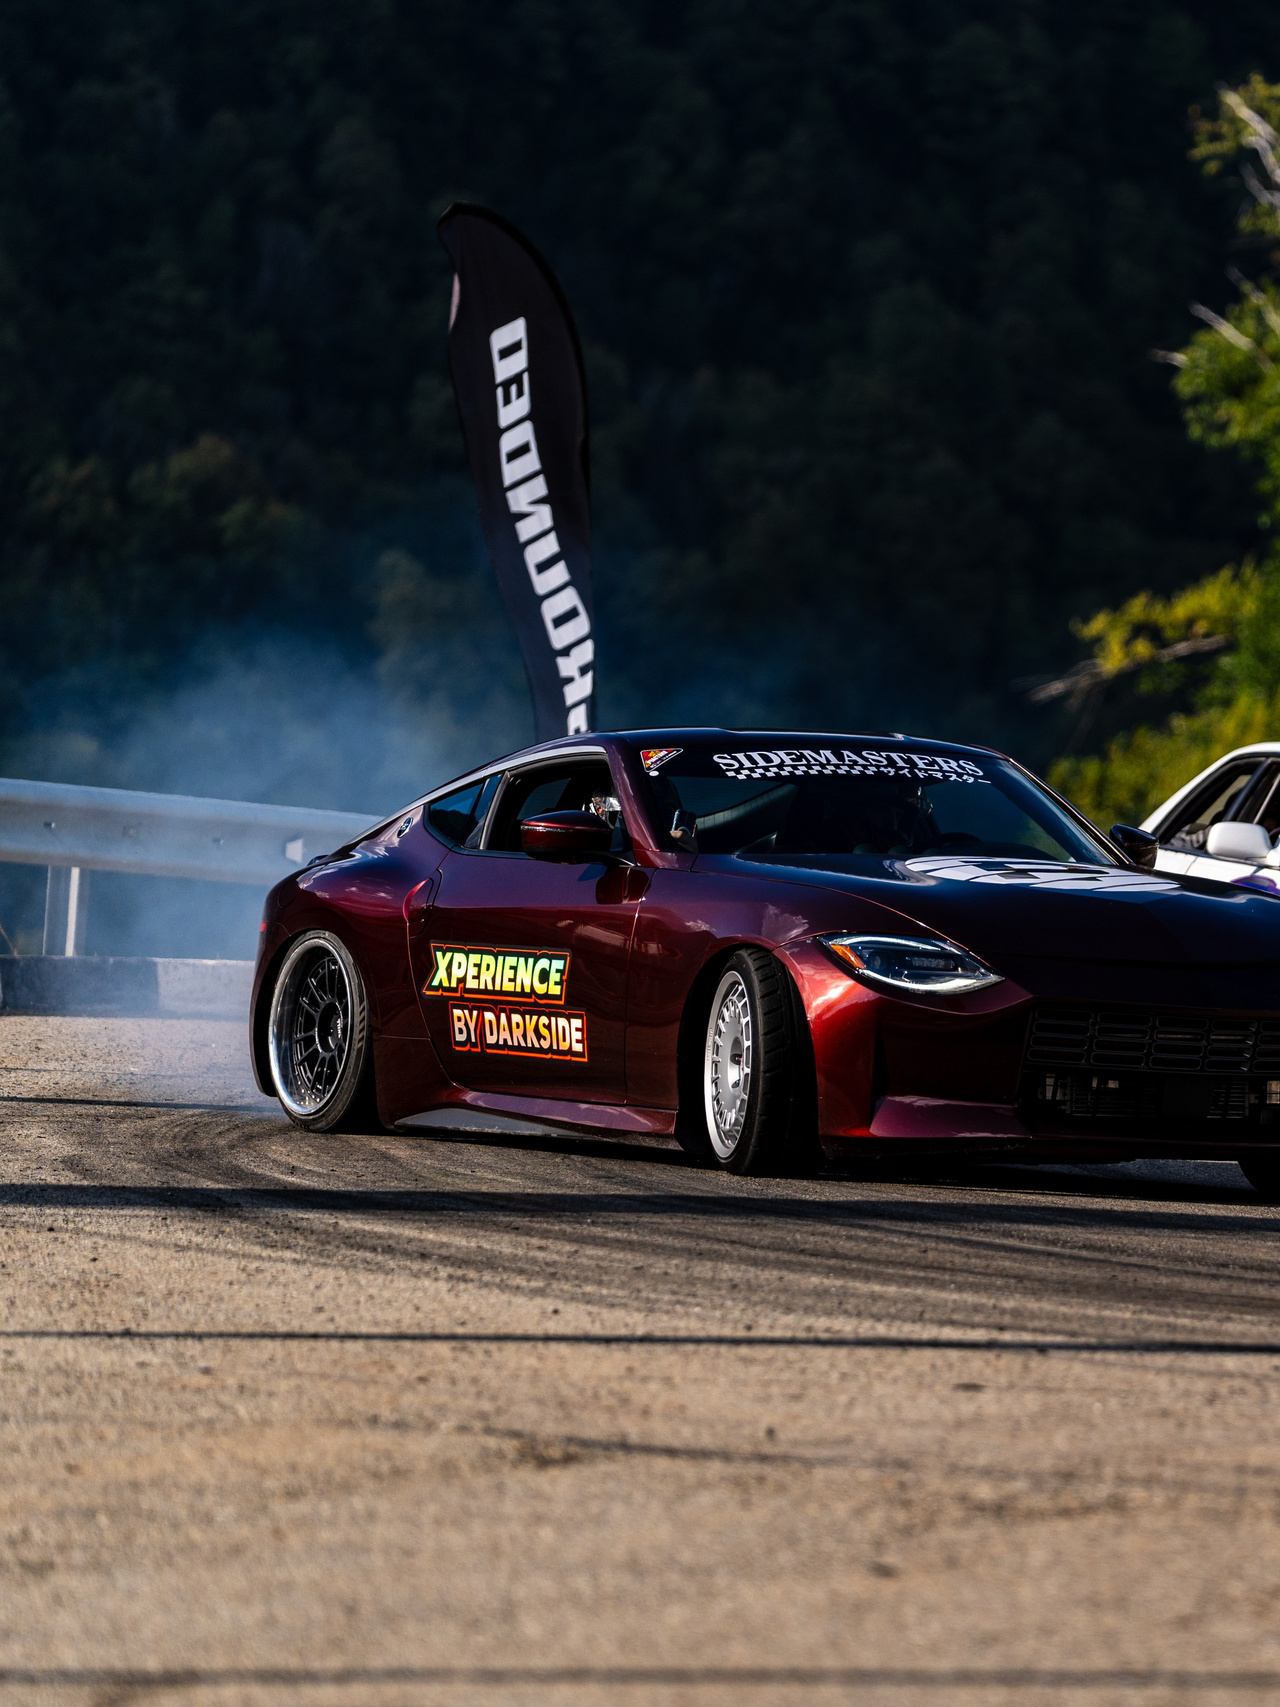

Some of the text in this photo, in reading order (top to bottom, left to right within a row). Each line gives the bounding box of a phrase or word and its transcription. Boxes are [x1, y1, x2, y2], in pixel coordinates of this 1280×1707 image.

[712, 750, 985, 777] SIDEMASTERS
[880, 766, 992, 784] サイドマスター
[431, 951, 566, 996] XPERIENCE
[452, 1008, 584, 1053] BY DARKSIDE
